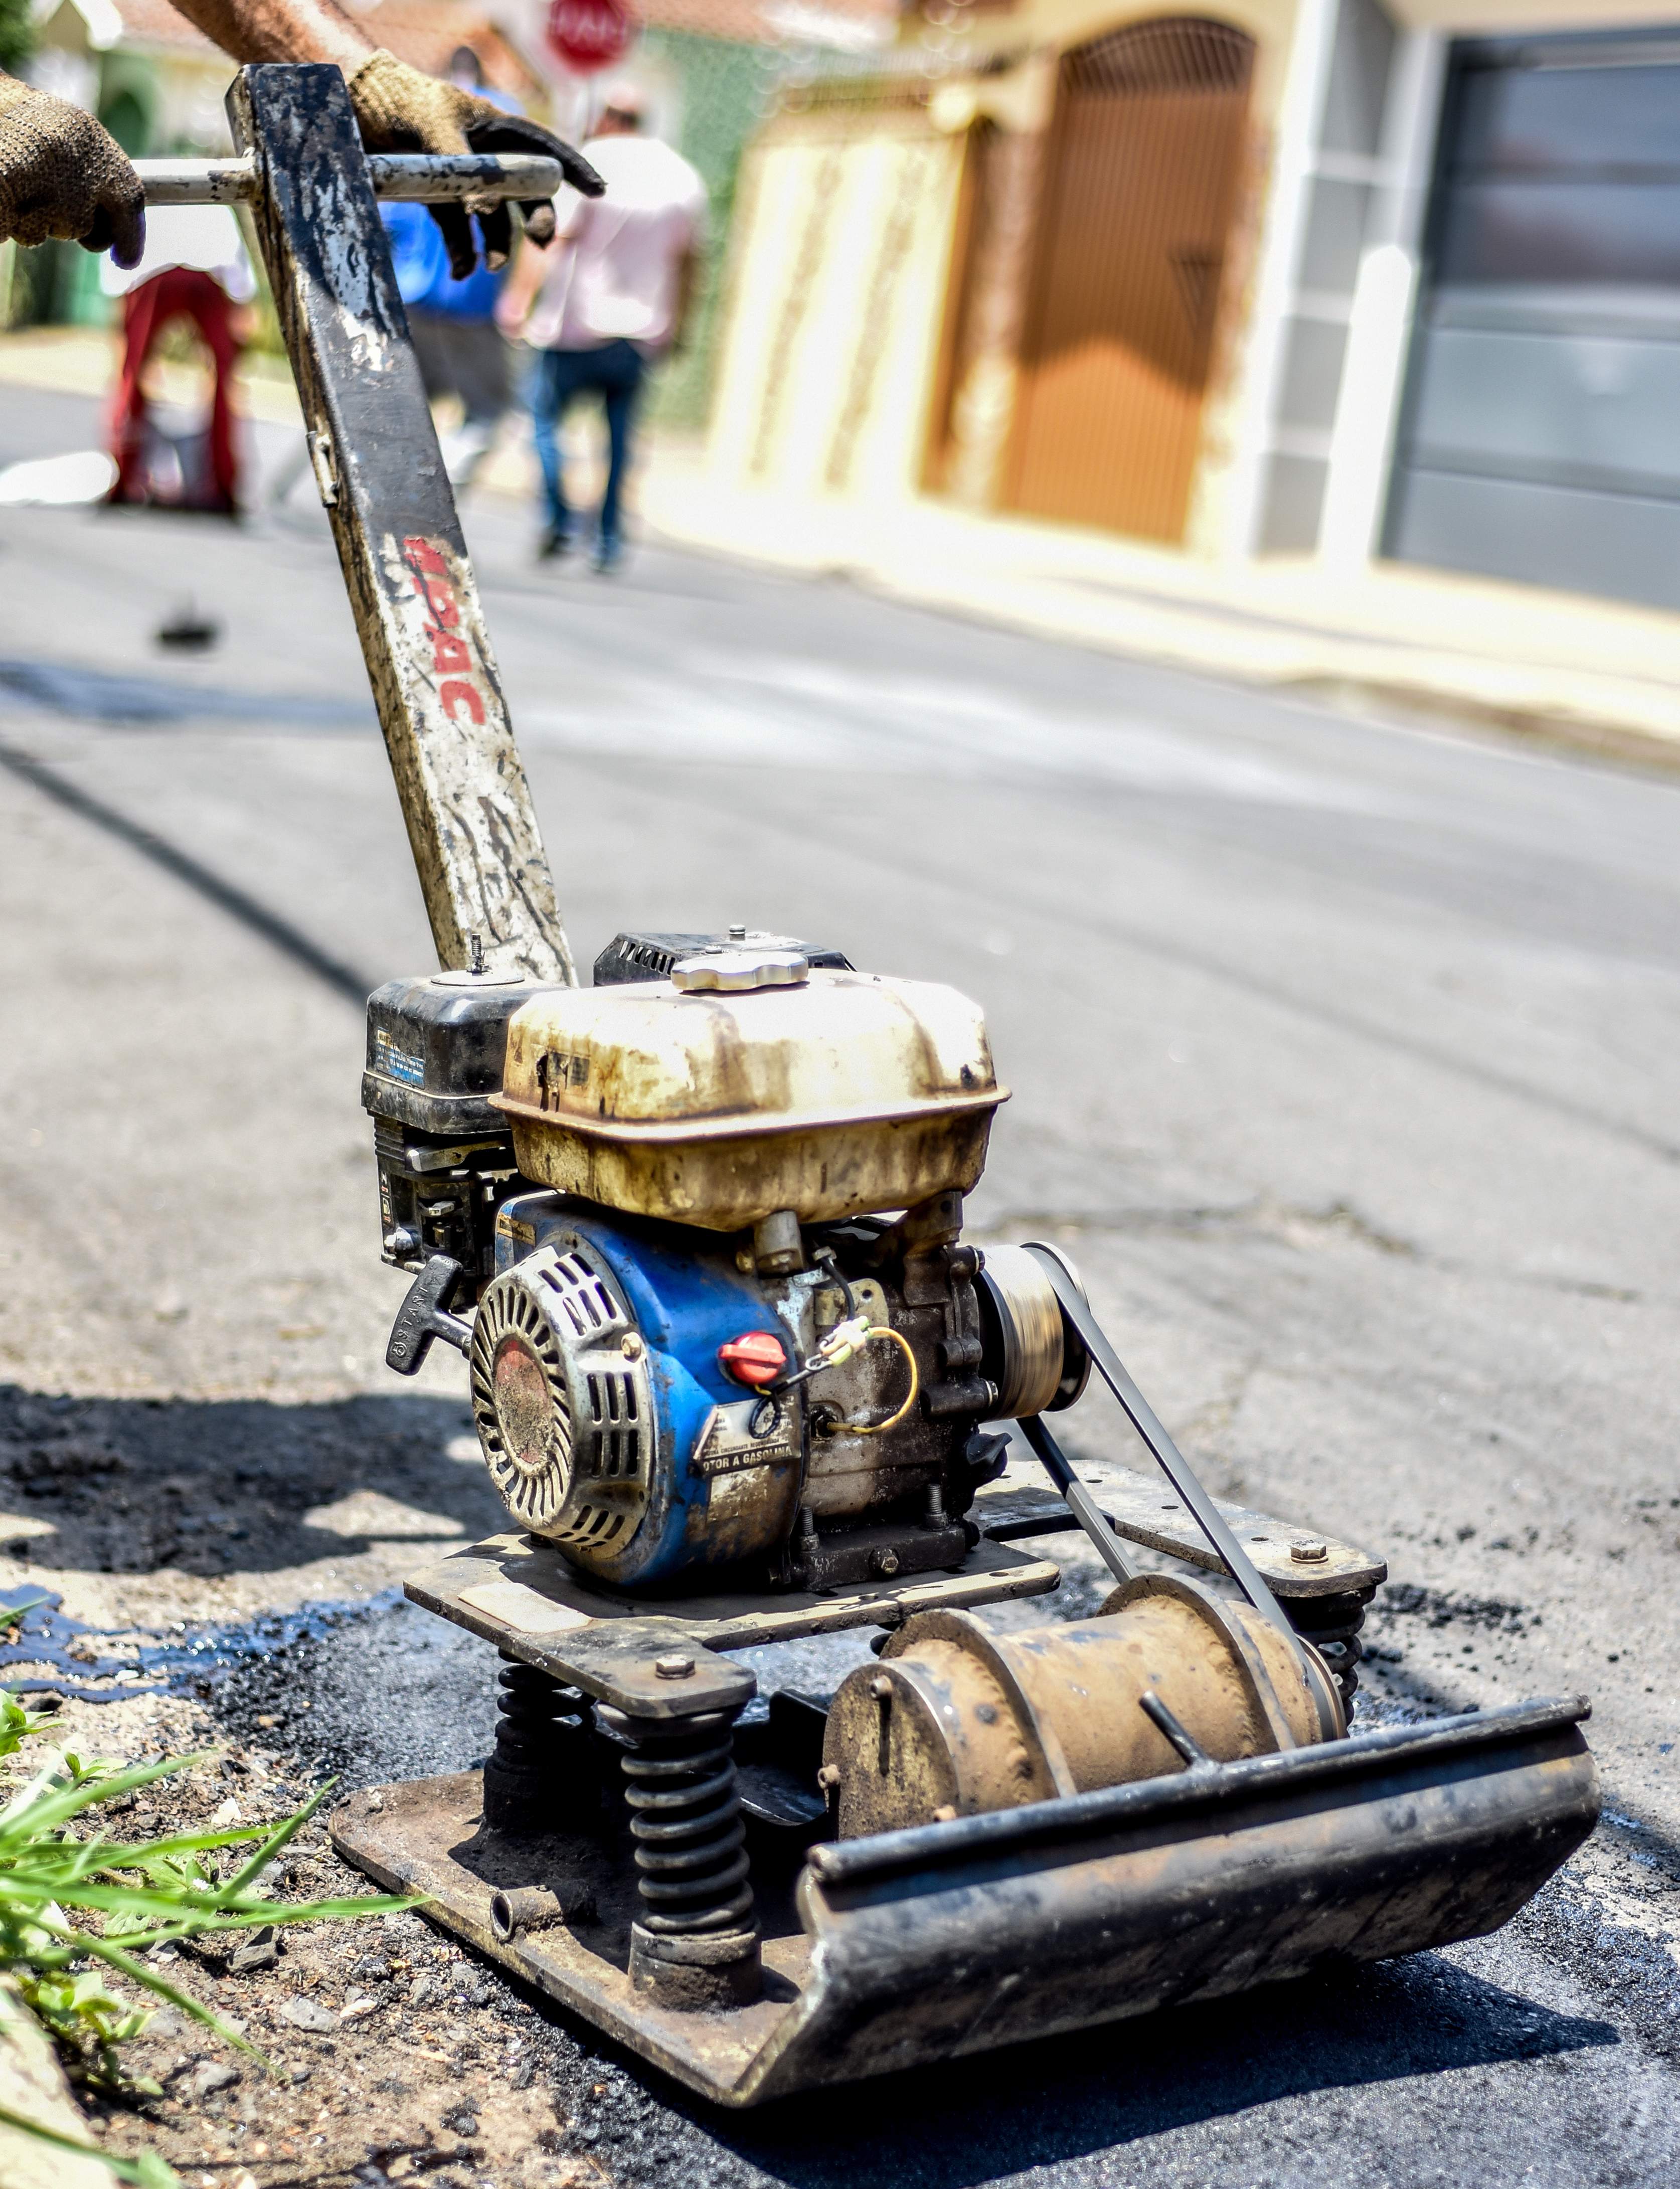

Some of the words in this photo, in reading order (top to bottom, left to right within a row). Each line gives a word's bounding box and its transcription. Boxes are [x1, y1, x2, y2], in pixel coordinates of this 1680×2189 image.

[397, 1286, 429, 1340] START
[702, 1457, 729, 1472] OTOR
[732, 1456, 740, 1466] A
